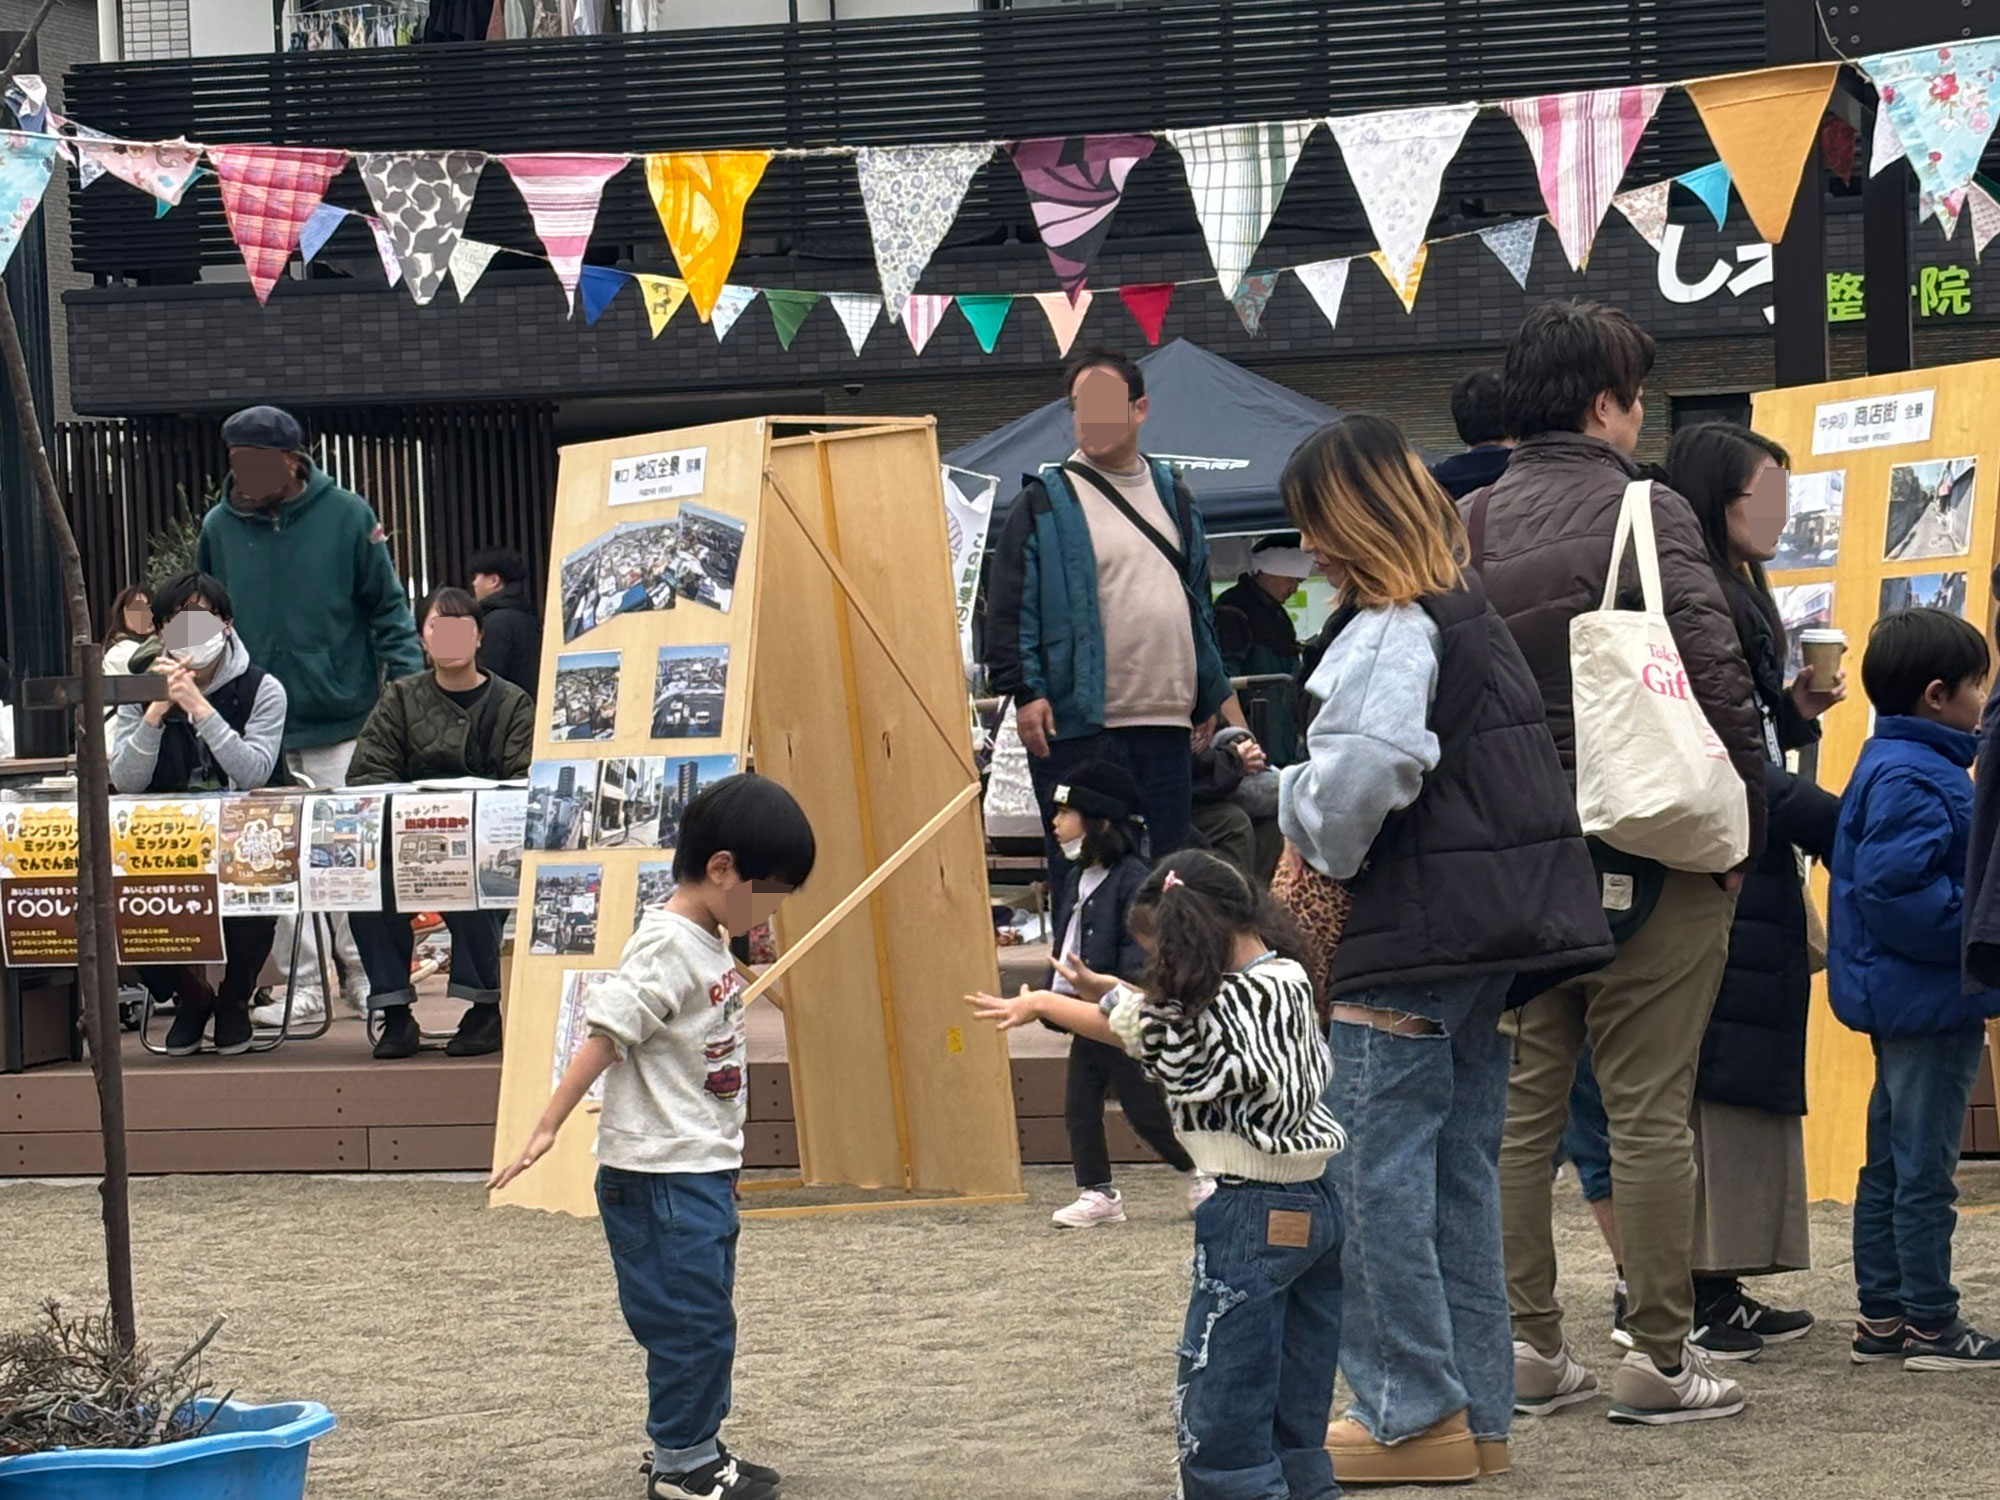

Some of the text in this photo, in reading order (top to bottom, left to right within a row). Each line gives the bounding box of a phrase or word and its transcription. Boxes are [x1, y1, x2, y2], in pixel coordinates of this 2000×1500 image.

[1826, 265, 1971, 322] 整院
[1854, 400, 1899, 427] 商店街
[634, 455, 680, 481] 地区全景
[1647, 643, 1680, 666] Toky
[1641, 663, 1689, 700] Gif
[18, 824, 79, 838] ビンゴラリ
[24, 839, 79, 852] ミッション
[135, 837, 191, 850] ミッション
[18, 856, 79, 871] でんでん会
[129, 854, 198, 869] でんでん会場
